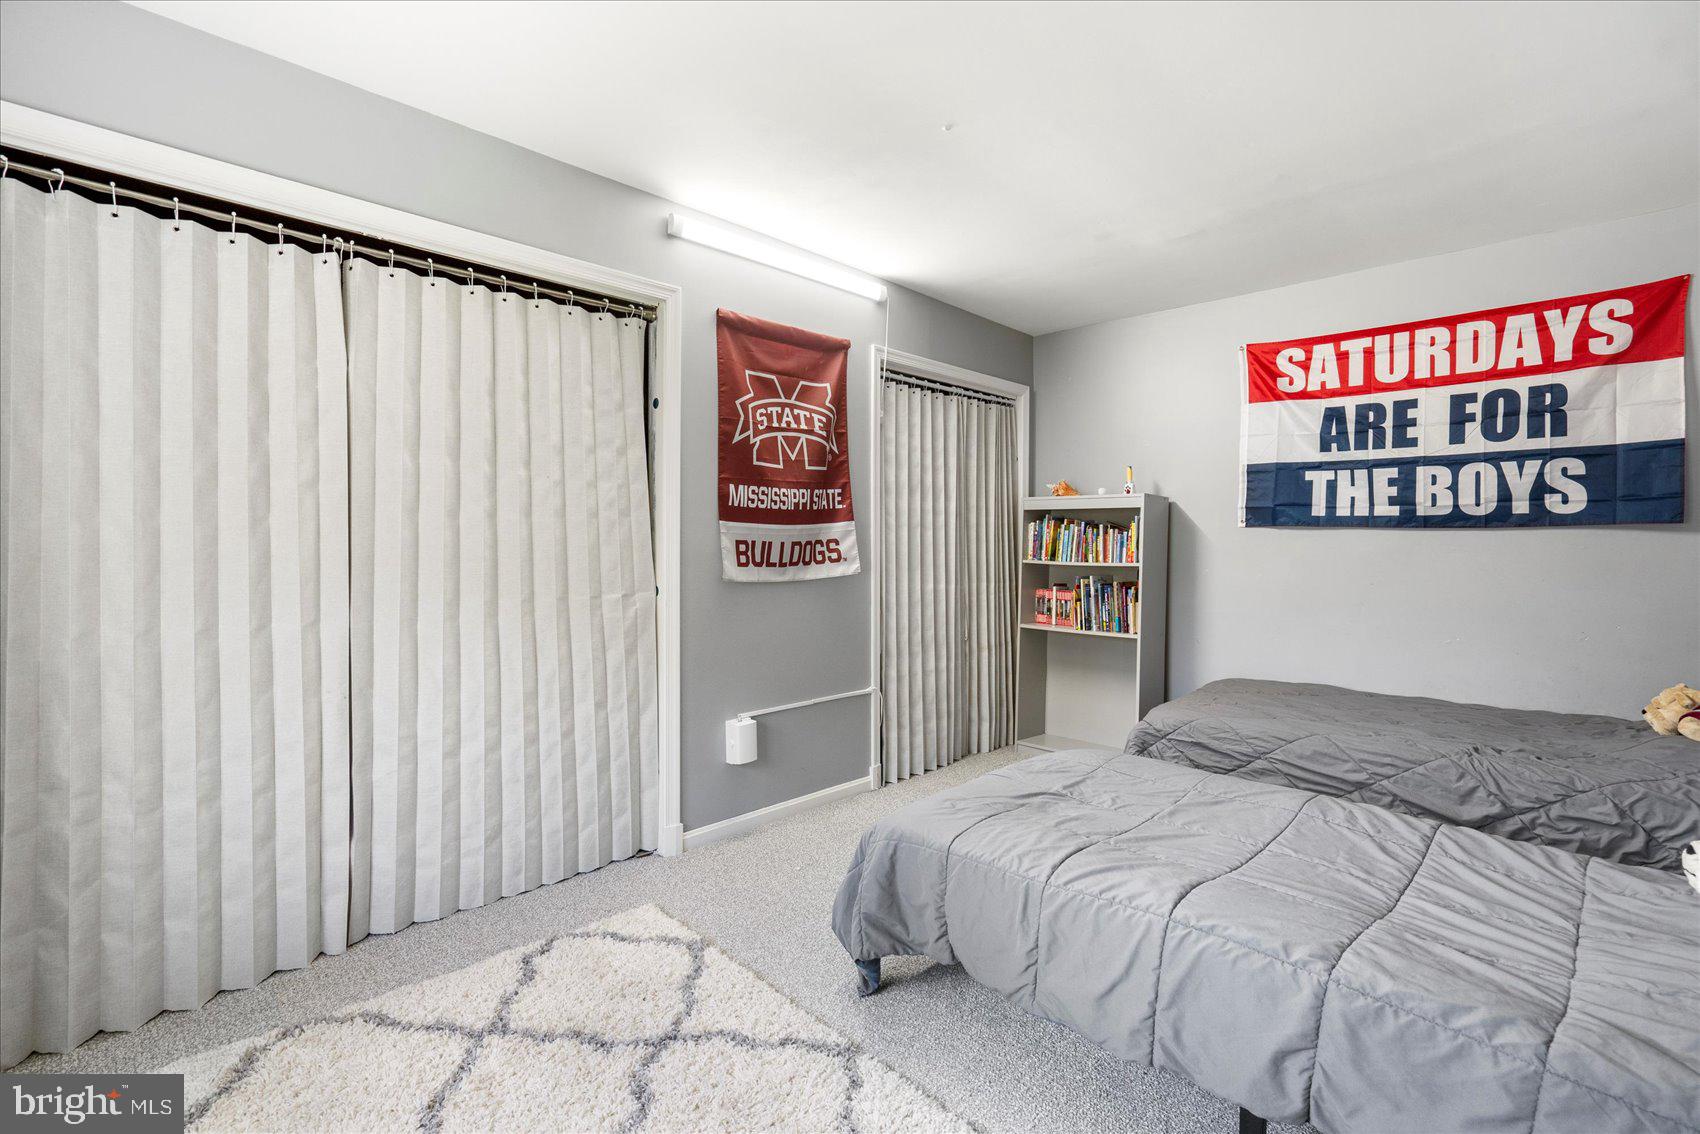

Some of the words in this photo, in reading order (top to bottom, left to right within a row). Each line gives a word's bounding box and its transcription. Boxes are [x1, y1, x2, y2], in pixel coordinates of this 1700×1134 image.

[1276, 298, 1635, 394] SATURDAYS
[755, 406, 827, 437] STATE
[1319, 398, 1419, 453] ARE
[1448, 383, 1569, 446] FOR
[728, 483, 811, 510] MISSISSIPPI
[1304, 467, 1400, 518] THE
[1415, 457, 1588, 517] BOYS
[735, 538, 843, 568] BULLDOGS
